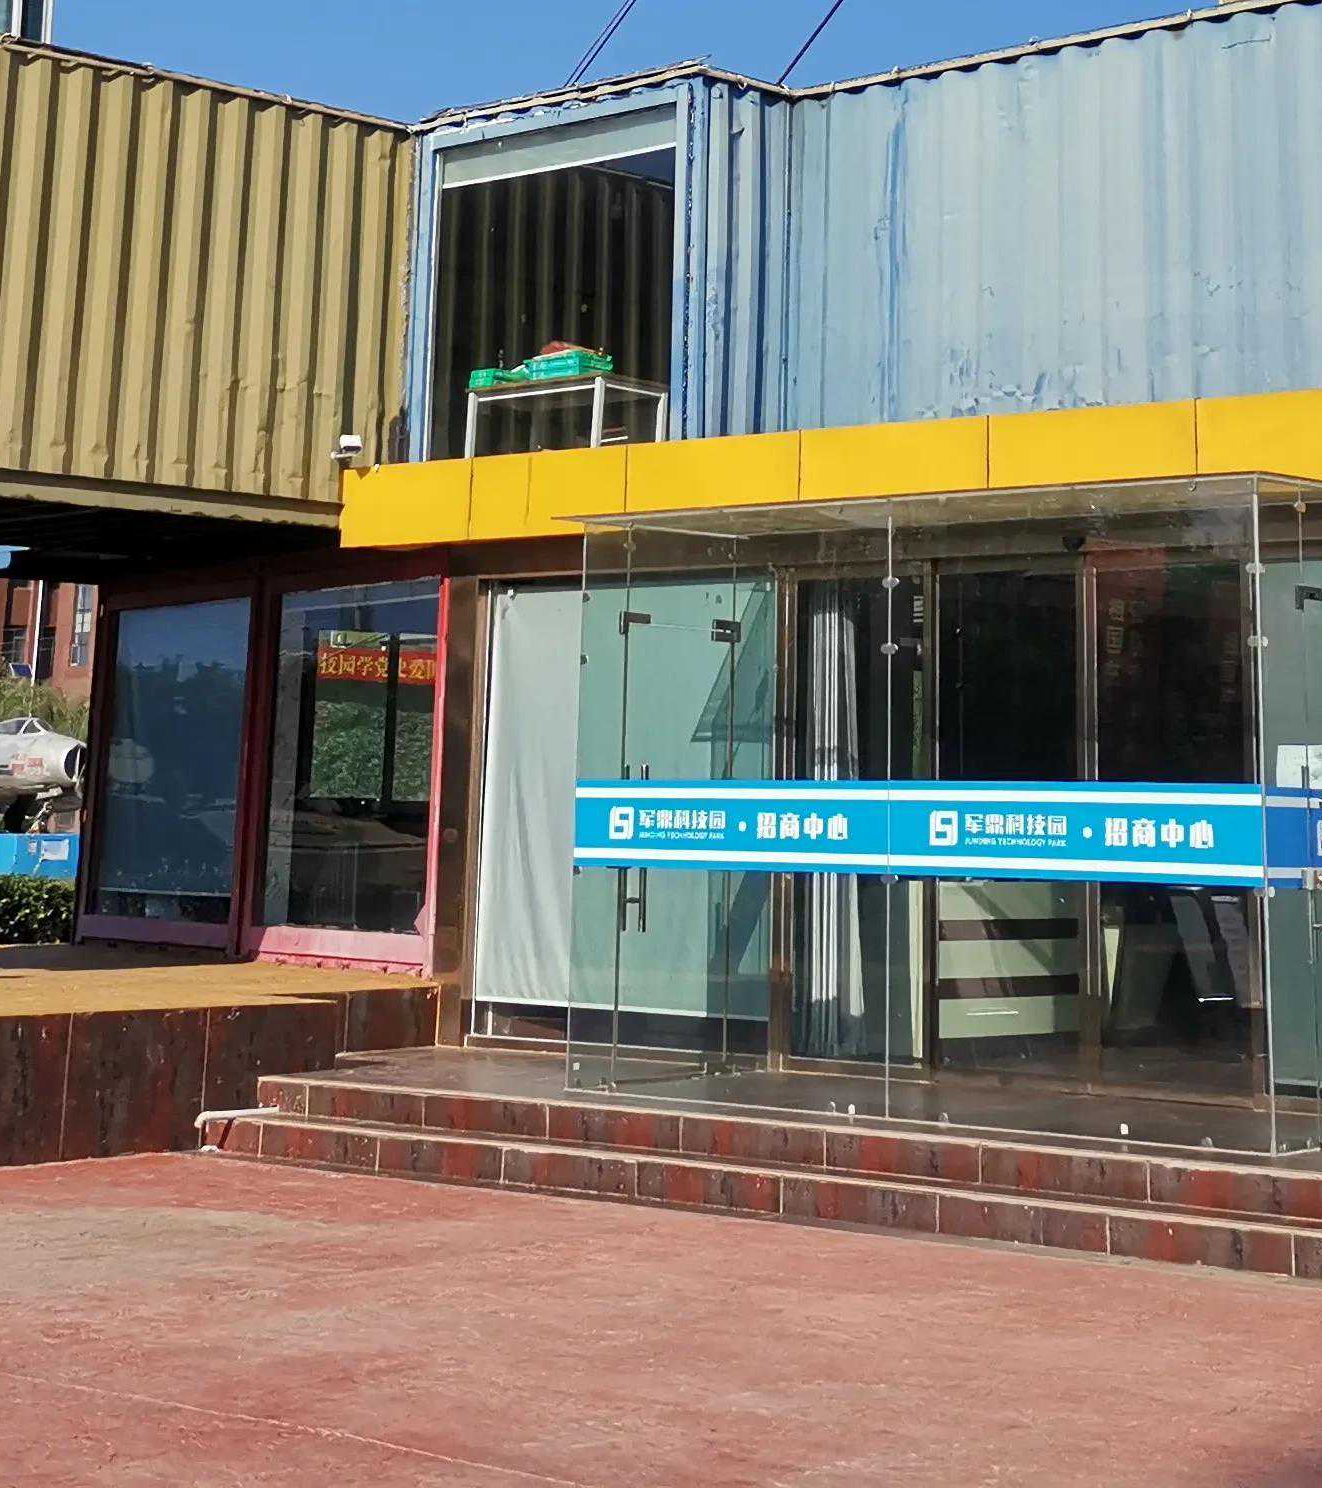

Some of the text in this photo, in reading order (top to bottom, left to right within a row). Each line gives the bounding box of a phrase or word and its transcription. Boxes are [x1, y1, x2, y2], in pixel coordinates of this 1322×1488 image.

[639, 809, 849, 841] 军鼎科技园 招商中心
[964, 813, 1214, 849] 军鼎科技园 招商中心
